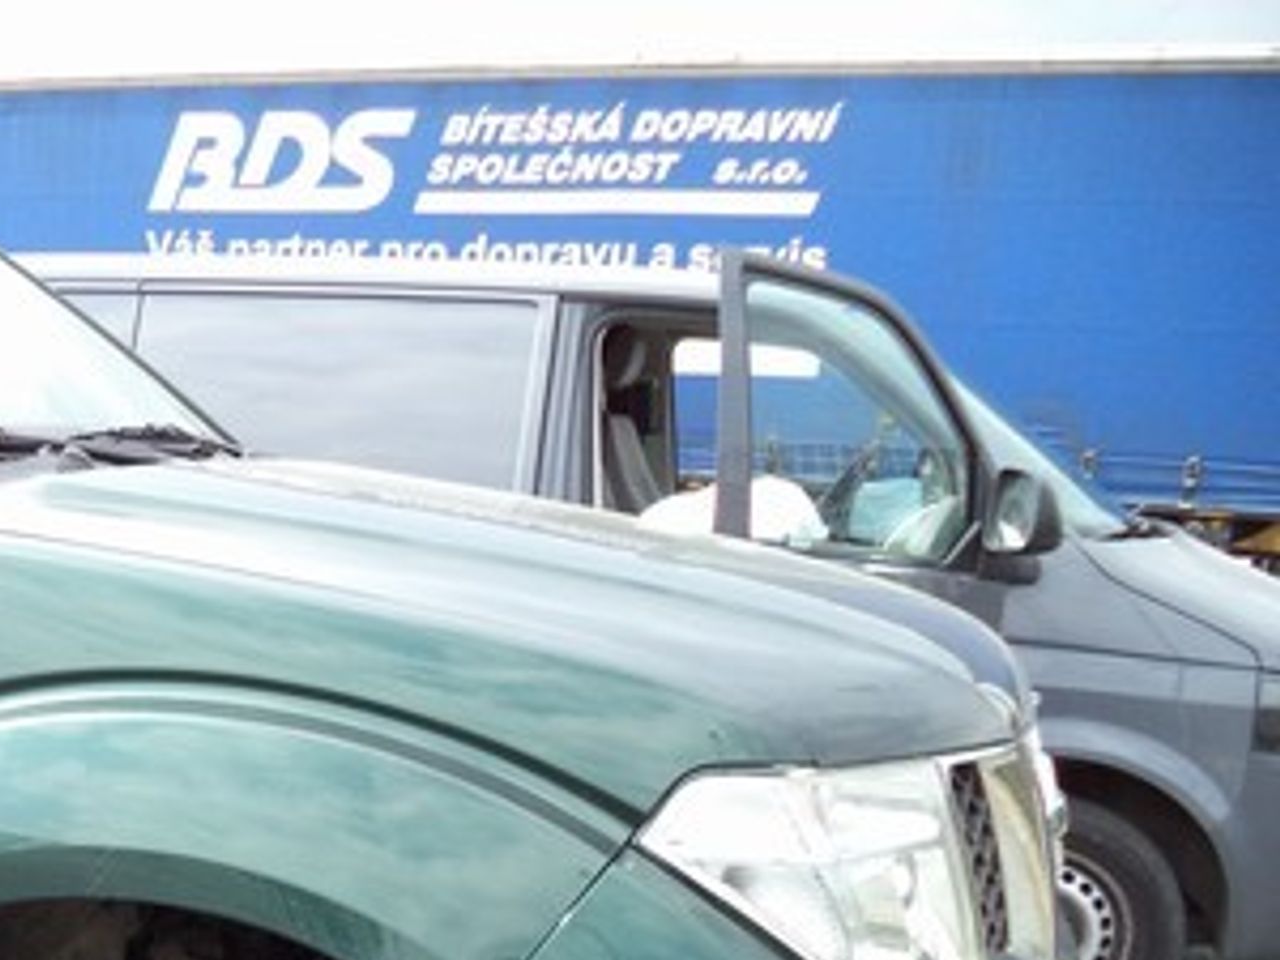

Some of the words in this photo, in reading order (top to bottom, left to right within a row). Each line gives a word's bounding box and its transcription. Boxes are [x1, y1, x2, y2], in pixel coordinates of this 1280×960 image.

[441, 103, 626, 144] BÍTEŠSKÁ
[630, 102, 842, 142] DOPRAVNÍ
[148, 109, 416, 213] BDS
[426, 146, 681, 183] SPOLEČNOST
[713, 157, 810, 184] s.r.o.
